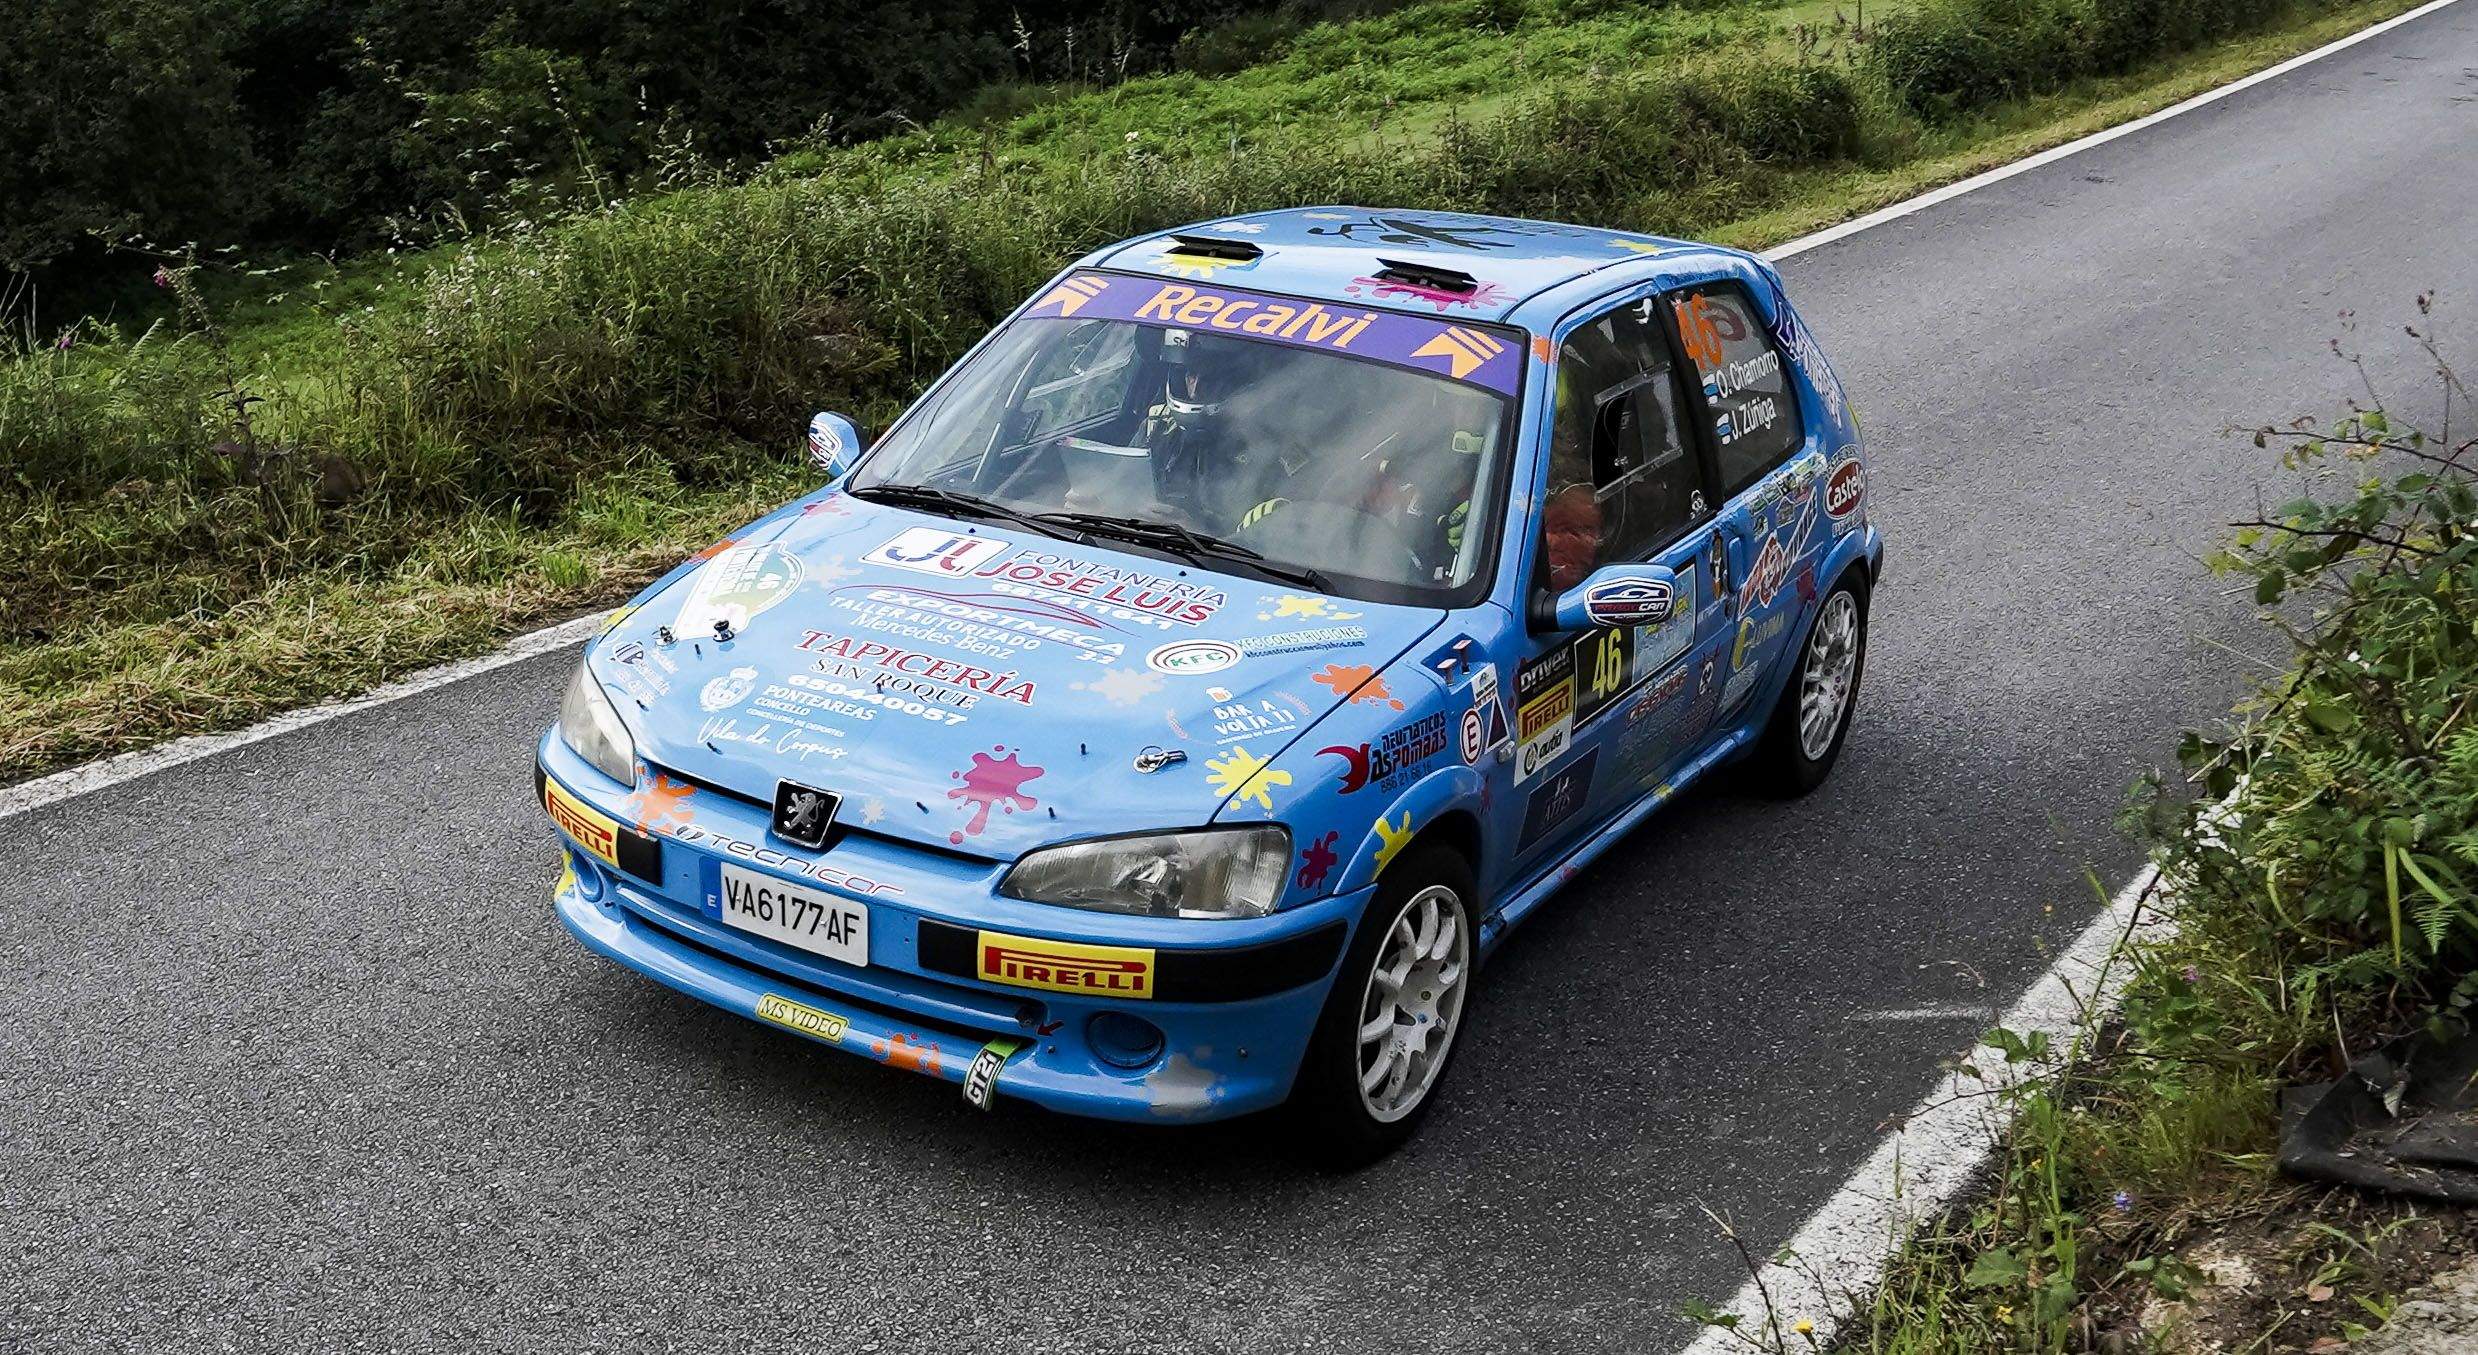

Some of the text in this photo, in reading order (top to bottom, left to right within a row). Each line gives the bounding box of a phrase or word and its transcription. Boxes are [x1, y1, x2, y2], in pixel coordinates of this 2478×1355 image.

[1134, 285, 1378, 348] Recalvi
[1729, 350, 1779, 391] Chamorro
[974, 562, 1216, 622] JOSE LUIS
[1015, 549, 1226, 606] FONTANERÍA
[829, 597, 1042, 651] TALLER AUTORIZADO
[866, 589, 1126, 657] EXPORTMECA
[797, 629, 1037, 705] TAPICERÍA
[812, 658, 978, 709] SAN ROQUE
[1592, 628, 1622, 700] 46
[754, 697, 812, 717] CONCELLO
[762, 684, 878, 721] PONTEAREAS
[788, 674, 969, 727] 650440057
[1521, 684, 1570, 740] PIRELLI
[547, 790, 613, 859] PIRELLI
[707, 876, 860, 947] E VA6177AF
[984, 945, 1148, 991] PIRELLI
[761, 999, 842, 1037] MS VIDEO
